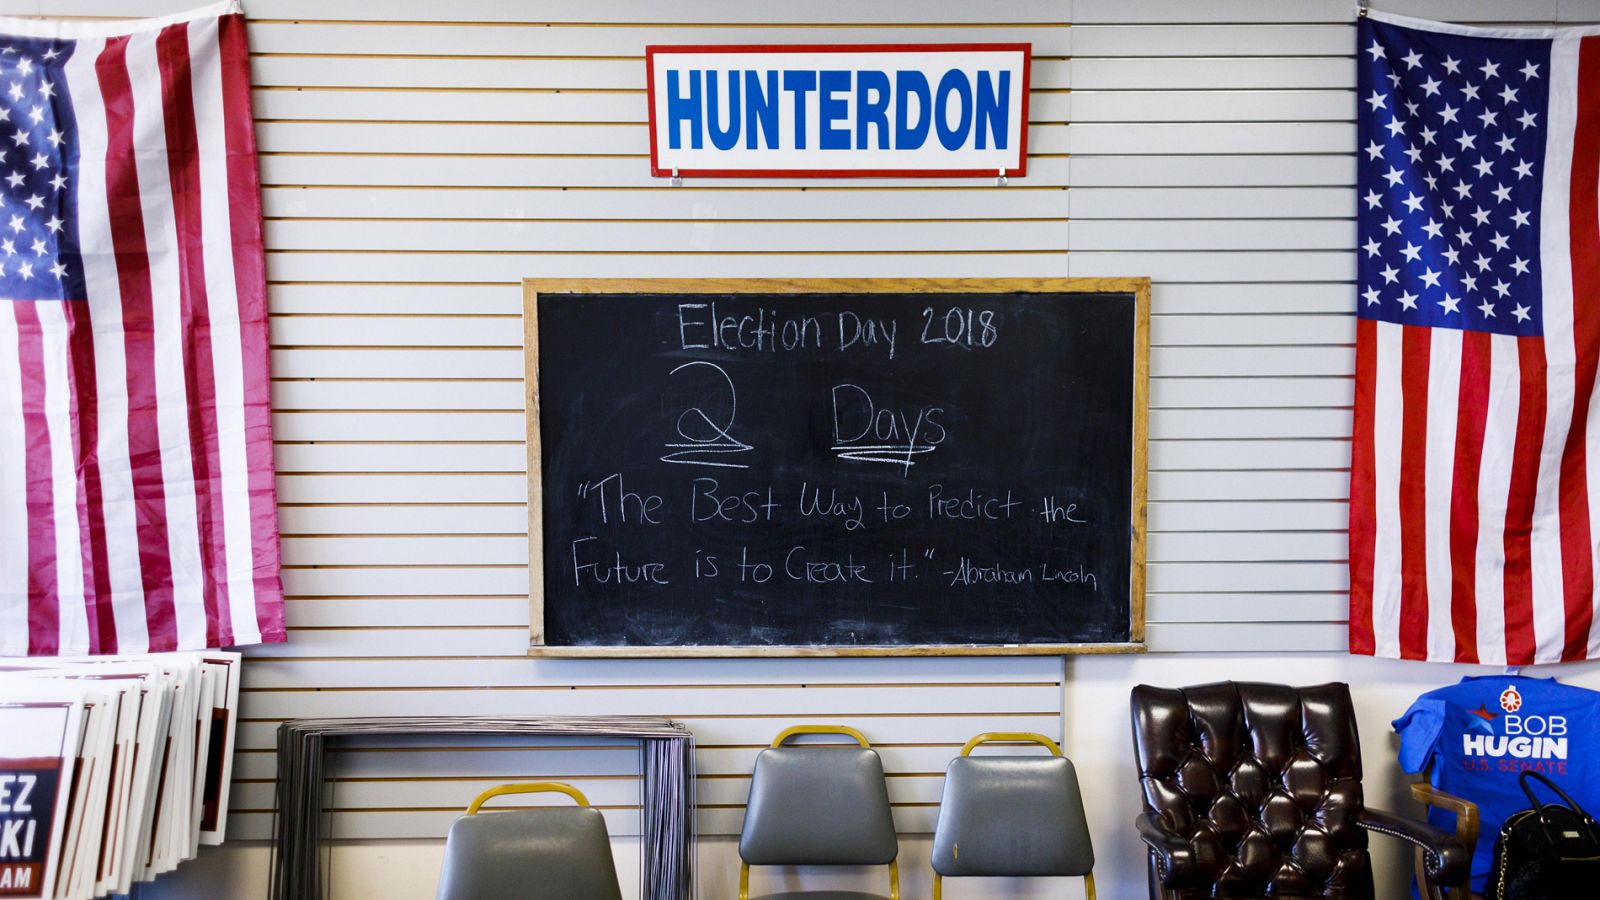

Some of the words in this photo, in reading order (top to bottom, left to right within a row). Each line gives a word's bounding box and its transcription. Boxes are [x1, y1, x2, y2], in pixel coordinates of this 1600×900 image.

[666, 68, 1011, 151] HUNTERDON
[678, 302, 821, 352] Election
[839, 311, 896, 359] Day
[920, 306, 997, 347] 2018
[669, 361, 754, 449] 2
[831, 383, 946, 478] Days
[577, 473, 663, 524] "The
[691, 477, 782, 523] Best
[799, 482, 866, 530] Way
[876, 491, 911, 523] to
[928, 484, 1023, 519] Predict
[1039, 496, 1087, 523] the
[572, 536, 669, 586] Future
[695, 550, 718, 578] is
[737, 547, 773, 583] to
[785, 546, 873, 583] Create
[1463, 734, 1568, 760] HUGIN
[1504, 715, 1568, 735] BOB
[1463, 759, 1493, 772] U.S.
[1499, 760, 1568, 775] SENATE
